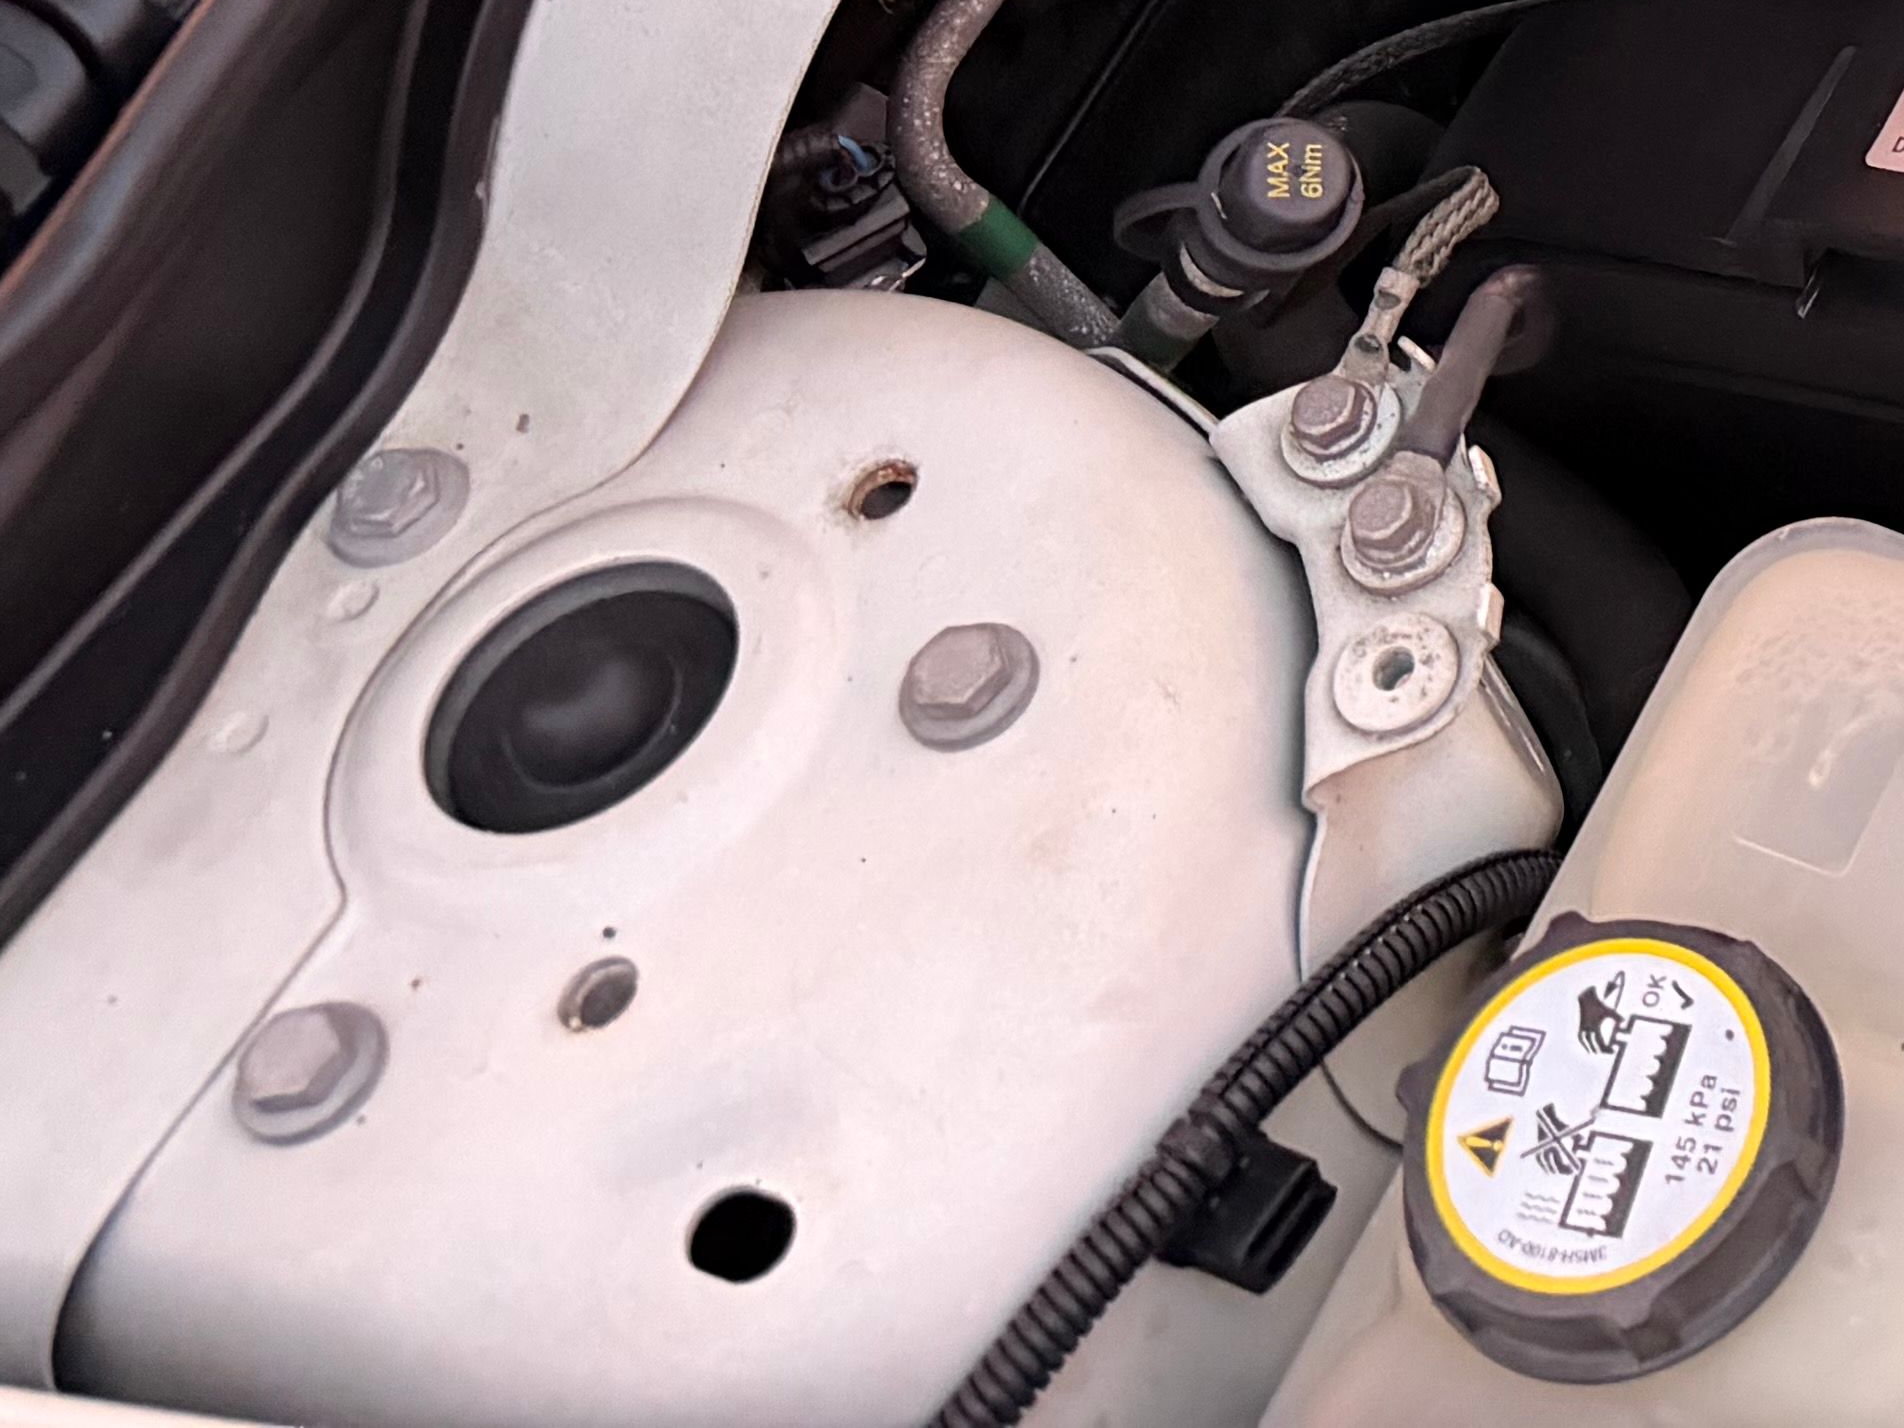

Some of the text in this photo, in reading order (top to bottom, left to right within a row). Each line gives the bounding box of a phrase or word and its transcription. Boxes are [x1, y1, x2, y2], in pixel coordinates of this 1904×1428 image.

[1266, 142, 1289, 199] MAX
[1301, 143, 1323, 199] 6Nm
[1642, 973, 1667, 1008] OK
[1666, 1074, 1718, 1185] 145 kPa
[1695, 1087, 1742, 1175] 21 psi
